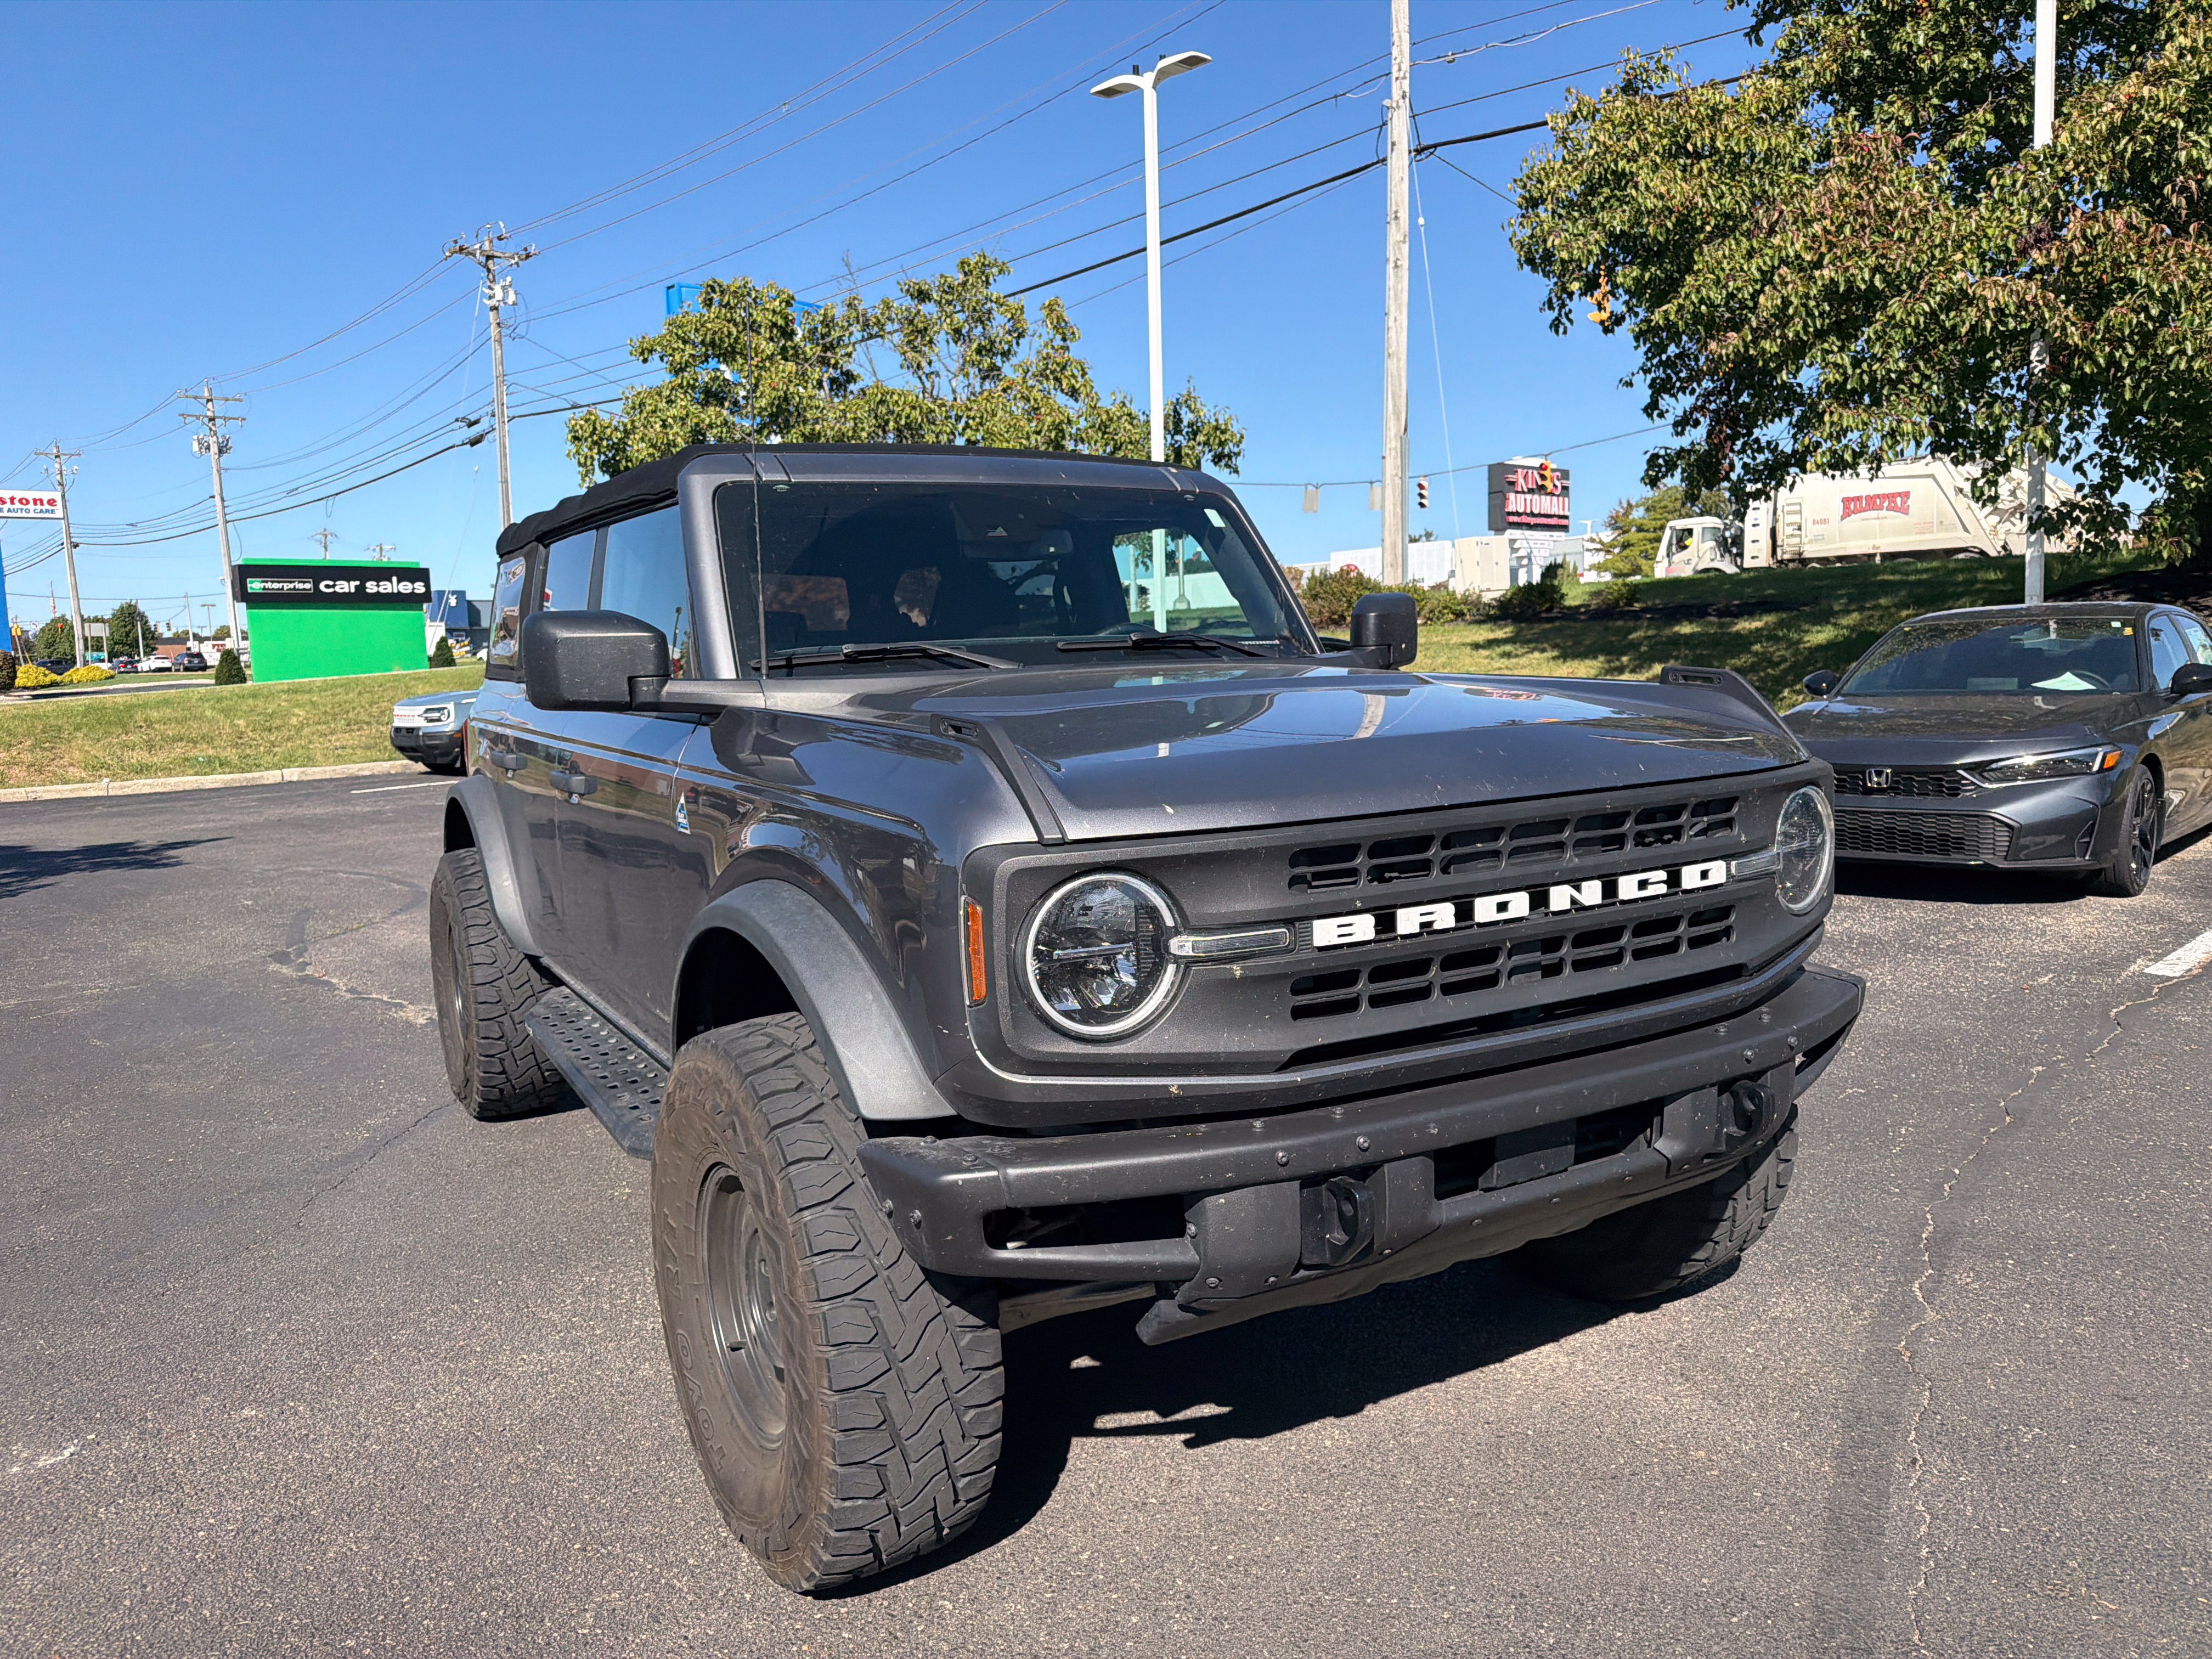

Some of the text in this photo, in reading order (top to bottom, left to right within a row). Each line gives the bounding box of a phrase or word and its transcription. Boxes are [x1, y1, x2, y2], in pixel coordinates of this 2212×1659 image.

[1515, 469, 1561, 495] KINS
[0, 495, 57, 506] stone
[1505, 493, 1570, 516] AUTOMALL
[1840, 490, 1910, 521] RUMPKE
[250, 576, 426, 594] enterprise car sales
[1312, 860, 1726, 947] BRONCO
[676, 1331, 726, 1473] TOYO
